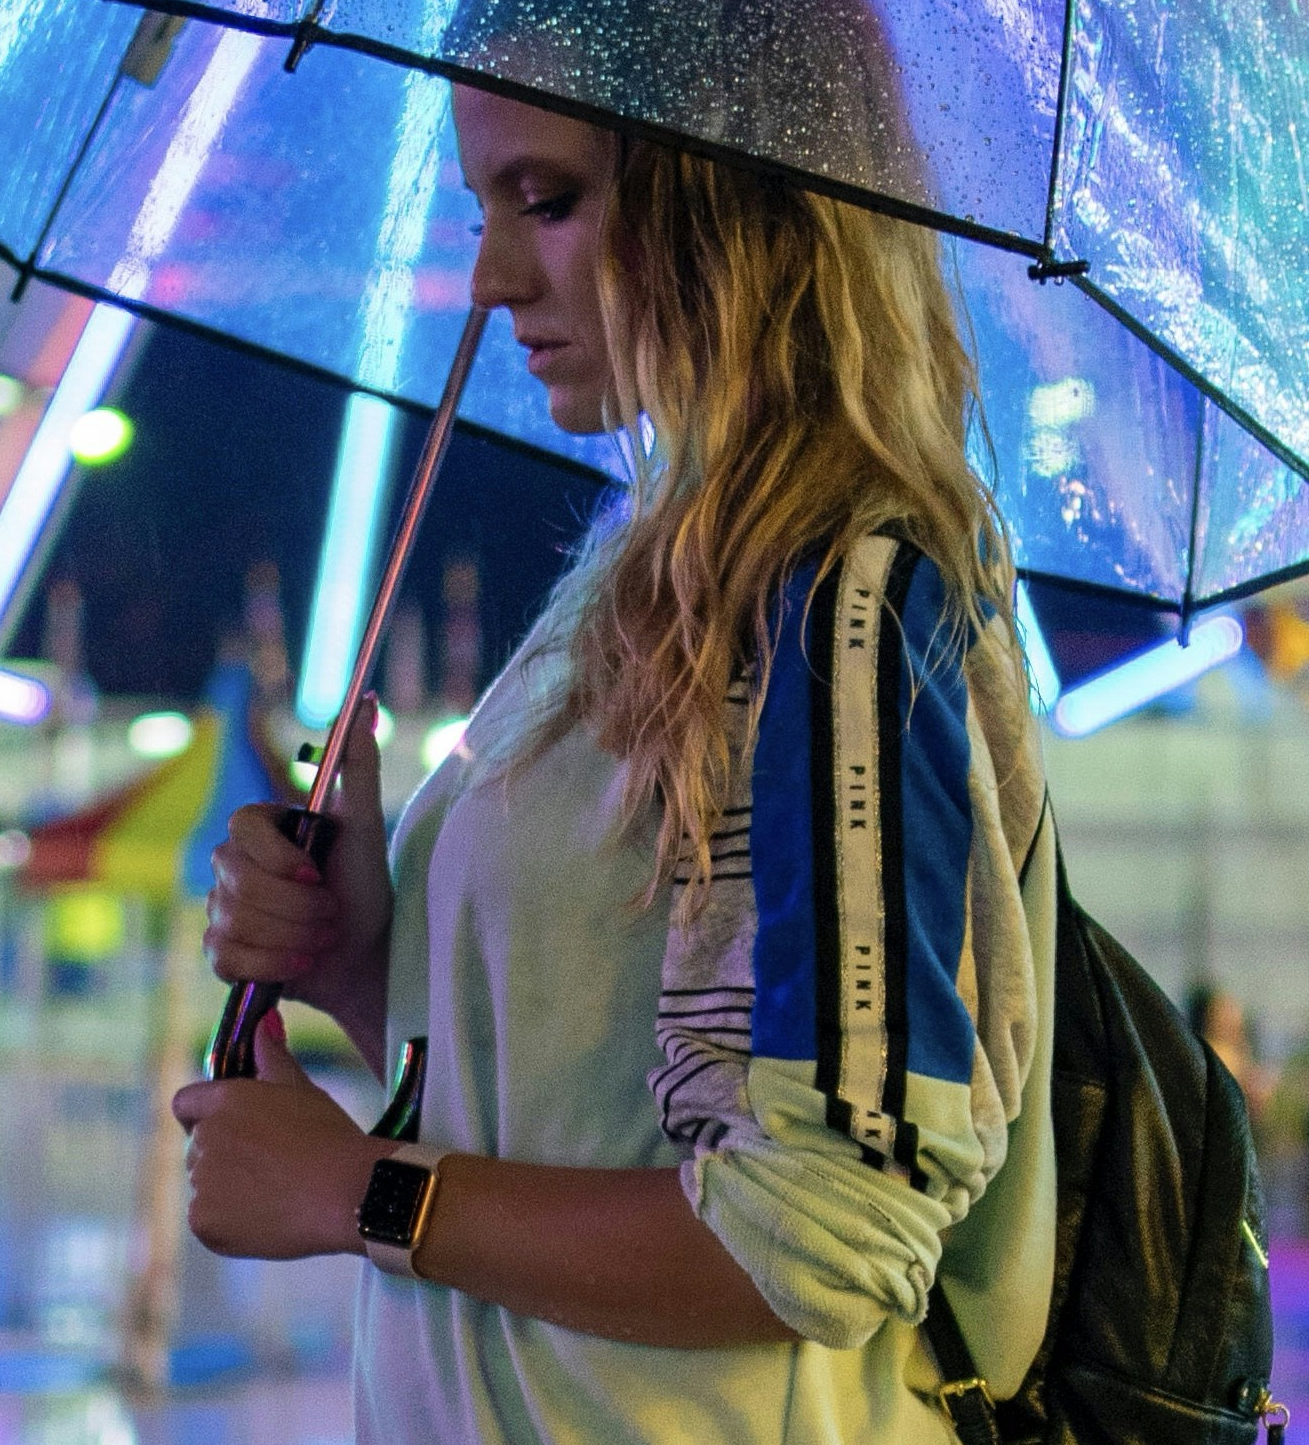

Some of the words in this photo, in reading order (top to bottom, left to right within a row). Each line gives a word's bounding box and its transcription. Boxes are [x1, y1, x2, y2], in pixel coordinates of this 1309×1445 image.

[849, 588, 871, 649] PINK
[849, 766, 866, 829] PINK
[855, 946, 871, 1010] PINK
